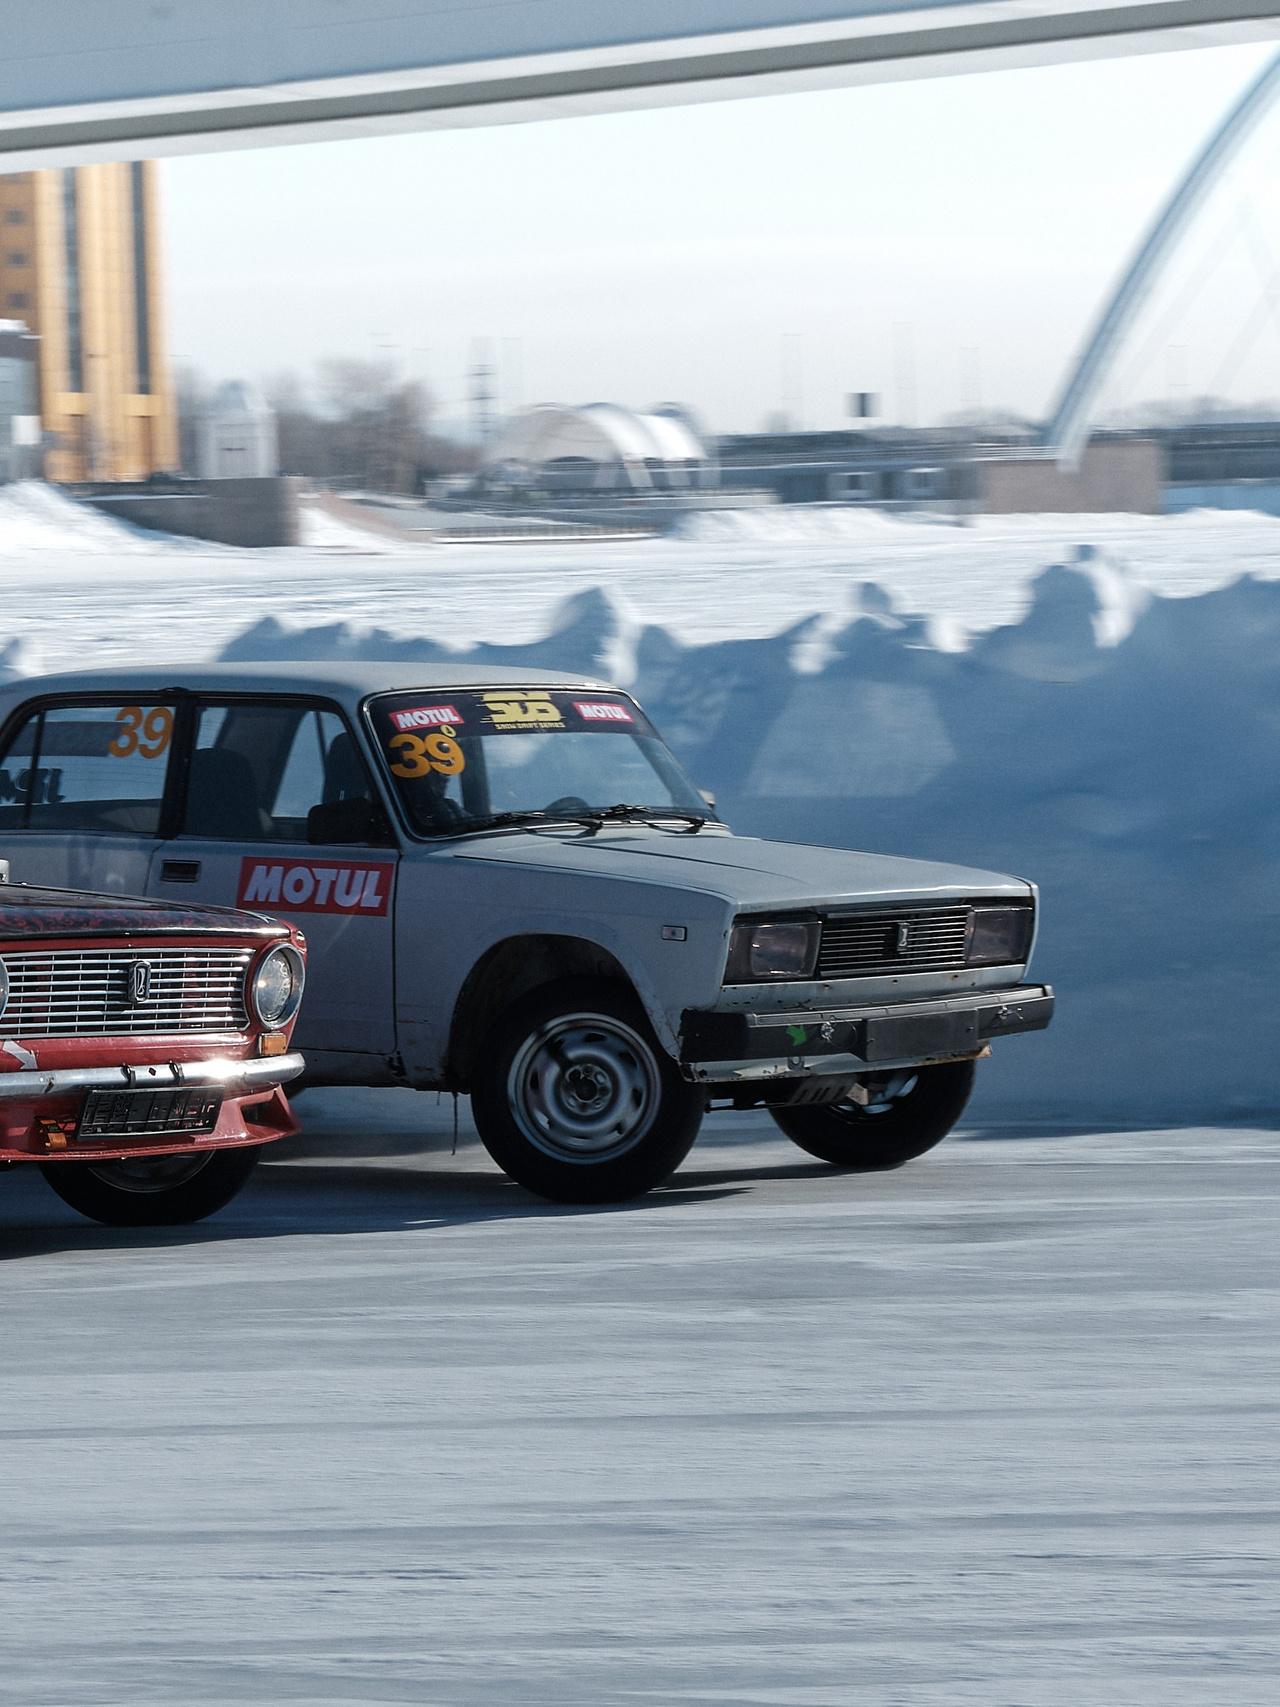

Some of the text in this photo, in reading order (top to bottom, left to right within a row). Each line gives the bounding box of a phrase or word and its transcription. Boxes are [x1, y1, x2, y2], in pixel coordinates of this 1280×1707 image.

[108, 706, 174, 759] 39
[396, 708, 460, 728] MOTUL
[579, 704, 631, 720] MOTUL
[389, 733, 466, 778] 39
[243, 865, 383, 908] MOTUL
